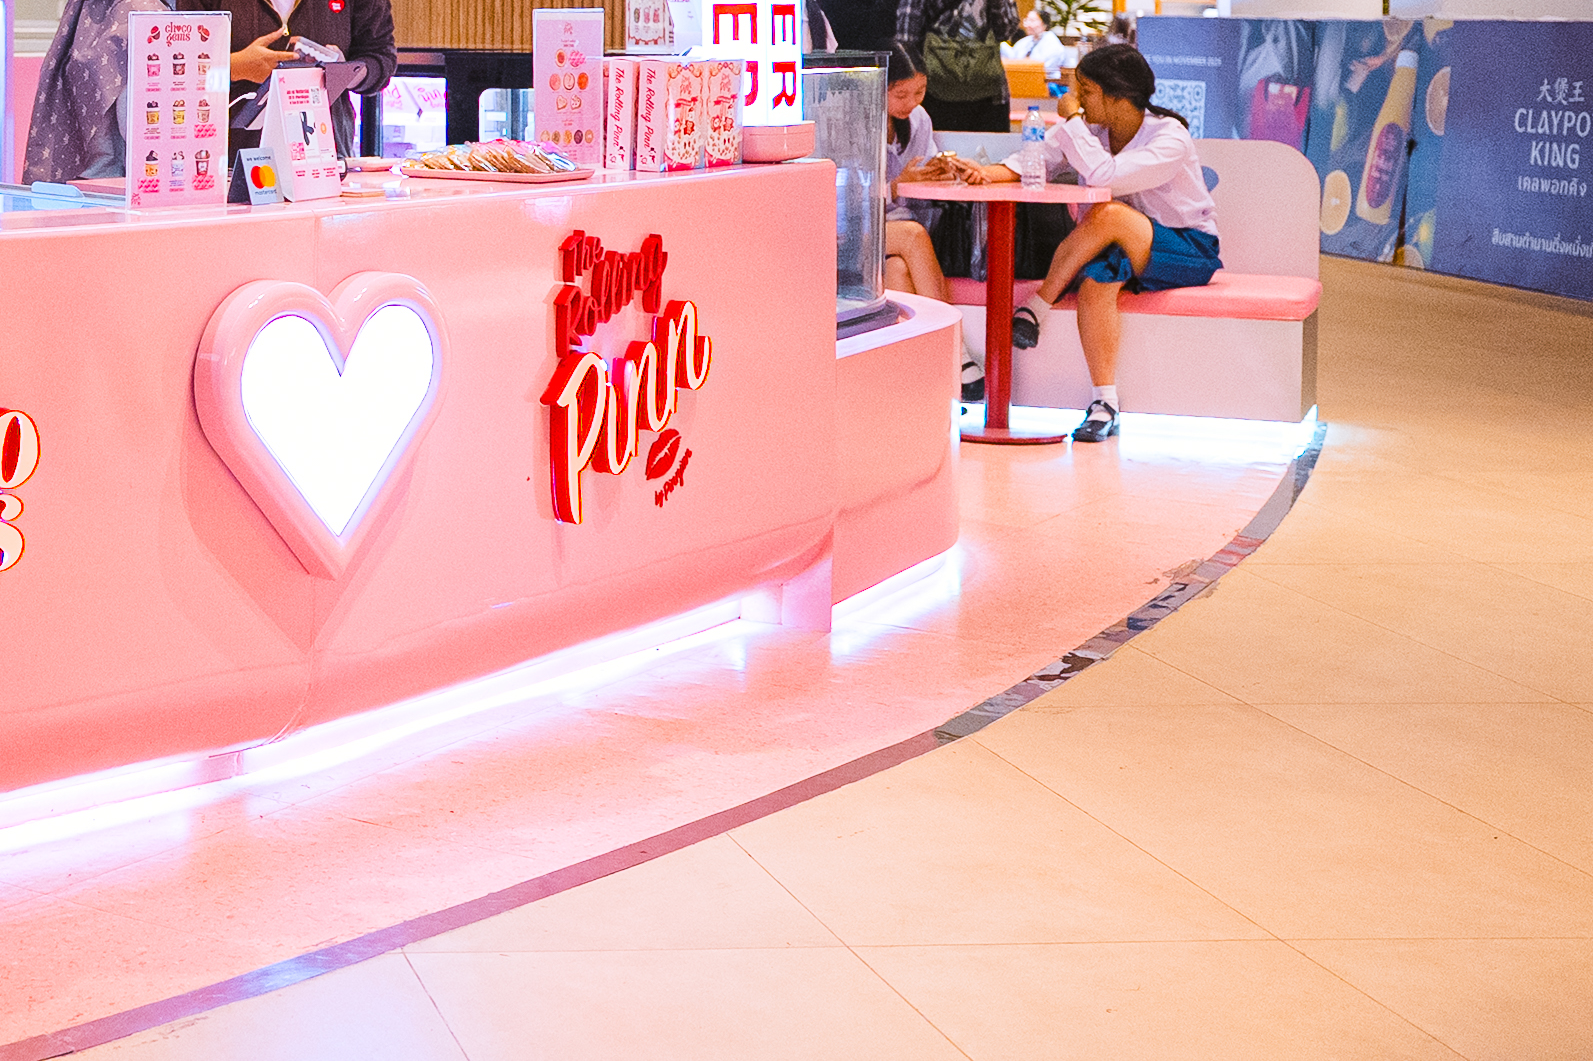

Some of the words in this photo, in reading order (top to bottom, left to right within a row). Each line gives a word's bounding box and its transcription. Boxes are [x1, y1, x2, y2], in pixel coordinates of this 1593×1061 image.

[615, 68, 625, 84] The
[646, 68, 656, 84] The
[610, 86, 625, 122] Rolling
[641, 86, 656, 123] Rolling
[1514, 108, 1593, 137] CLAYPO
[1530, 141, 1581, 169] KING
[558, 230, 604, 283] The
[553, 234, 668, 359] Rolling
[540, 300, 712, 525] Pinn
